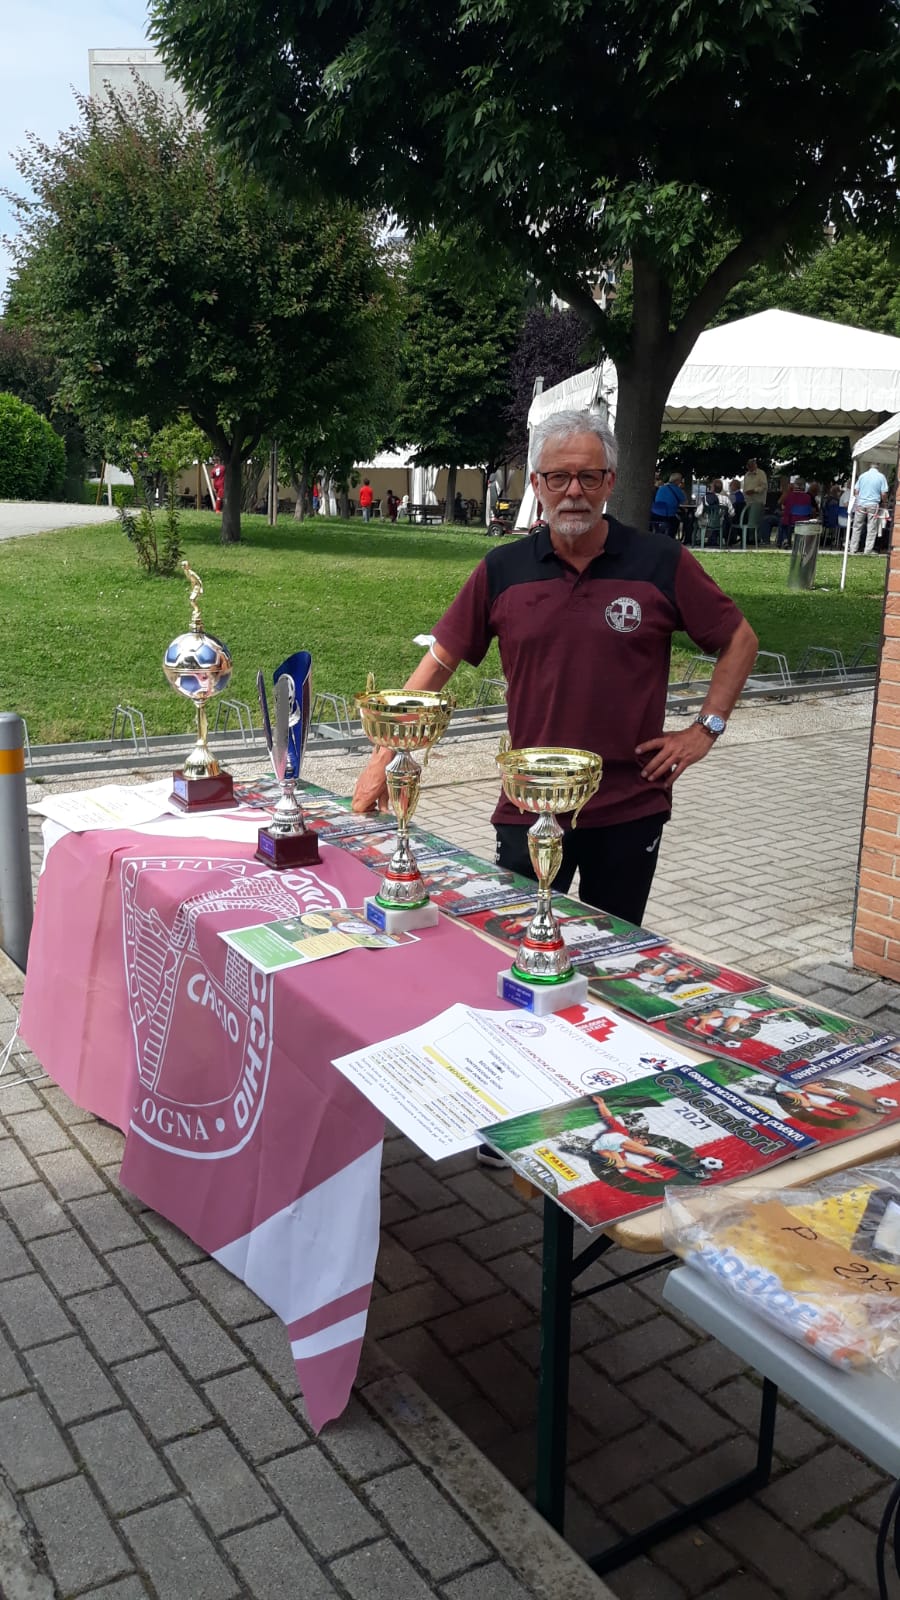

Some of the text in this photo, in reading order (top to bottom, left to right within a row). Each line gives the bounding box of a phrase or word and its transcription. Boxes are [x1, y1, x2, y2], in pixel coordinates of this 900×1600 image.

[783, 1032, 817, 1045] 2021
[587, 1072, 612, 1087] 365
[598, 1069, 620, 1084] BFC
[655, 1074, 788, 1155] Calciatori
[675, 1106, 712, 1130] 2021
[741, 1103, 760, 1116] PER
[757, 1111, 769, 1122] LA
[546, 1152, 576, 1178] PANINI
